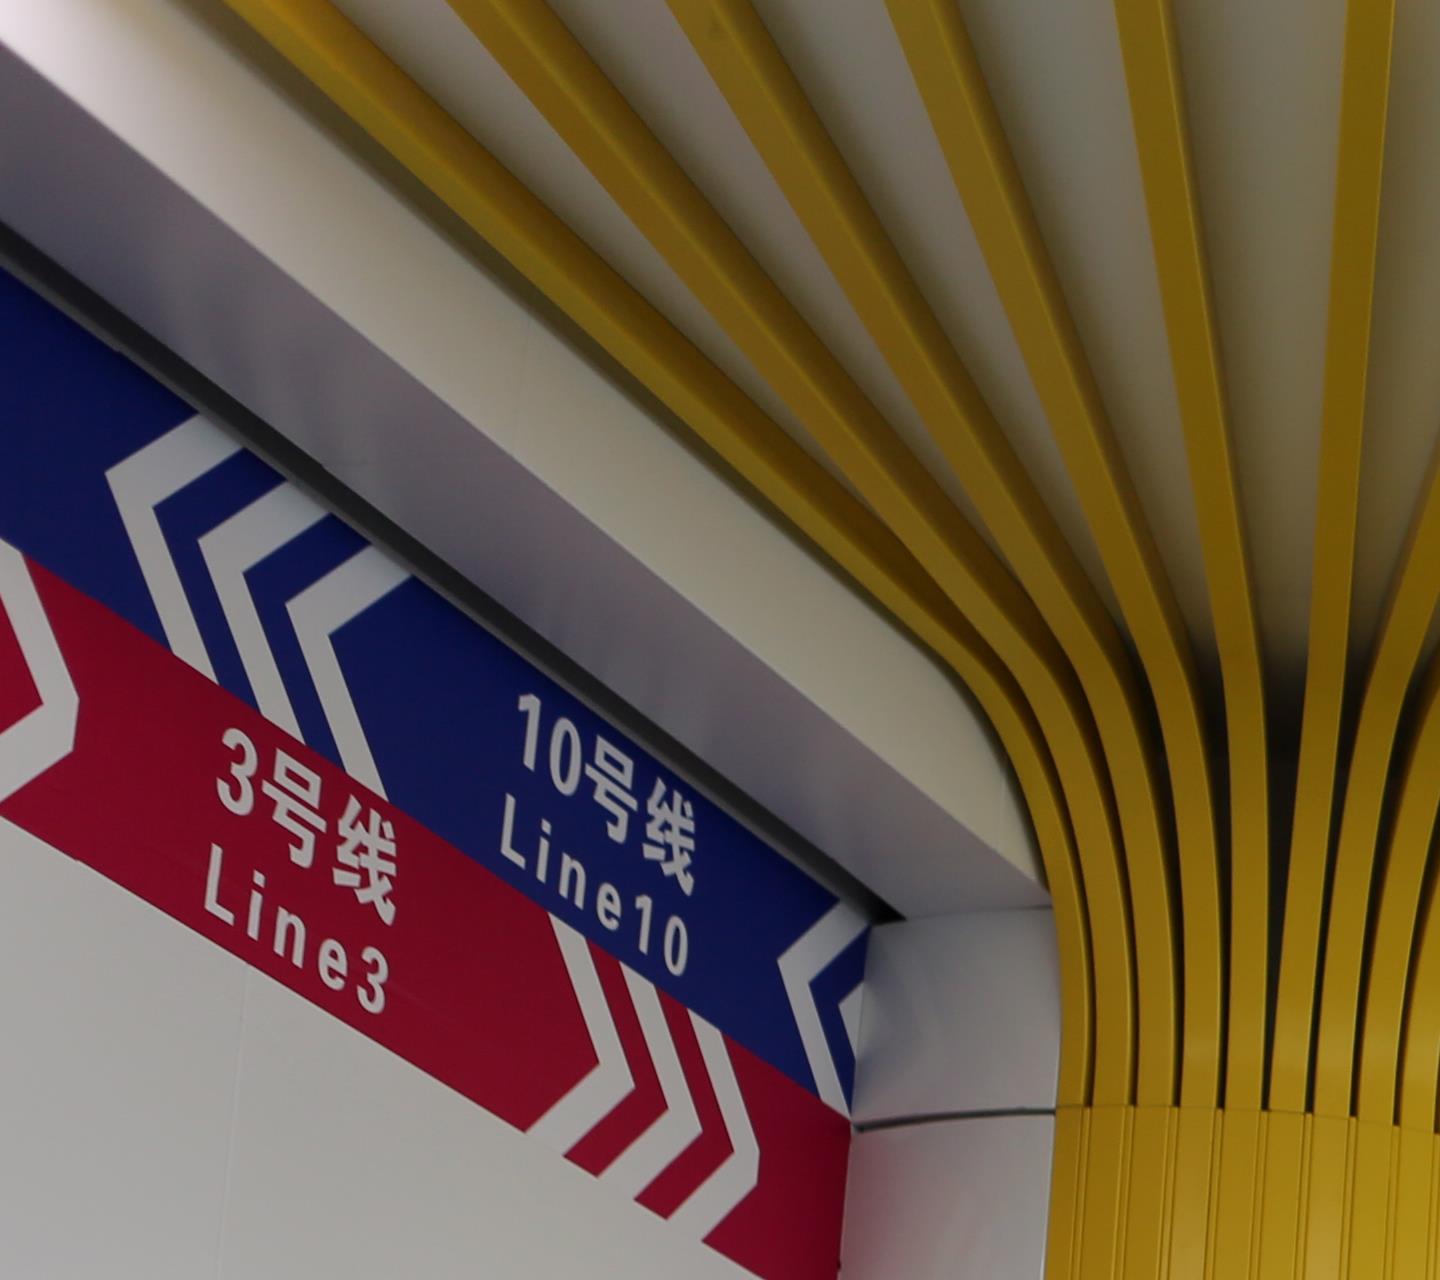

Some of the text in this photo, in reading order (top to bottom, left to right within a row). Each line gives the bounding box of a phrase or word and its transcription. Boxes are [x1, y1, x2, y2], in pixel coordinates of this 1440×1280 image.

[216, 728, 398, 926] 3号线
[501, 794, 689, 976] Line10
[518, 694, 696, 896] 10号线
[204, 843, 389, 1014] Line3
